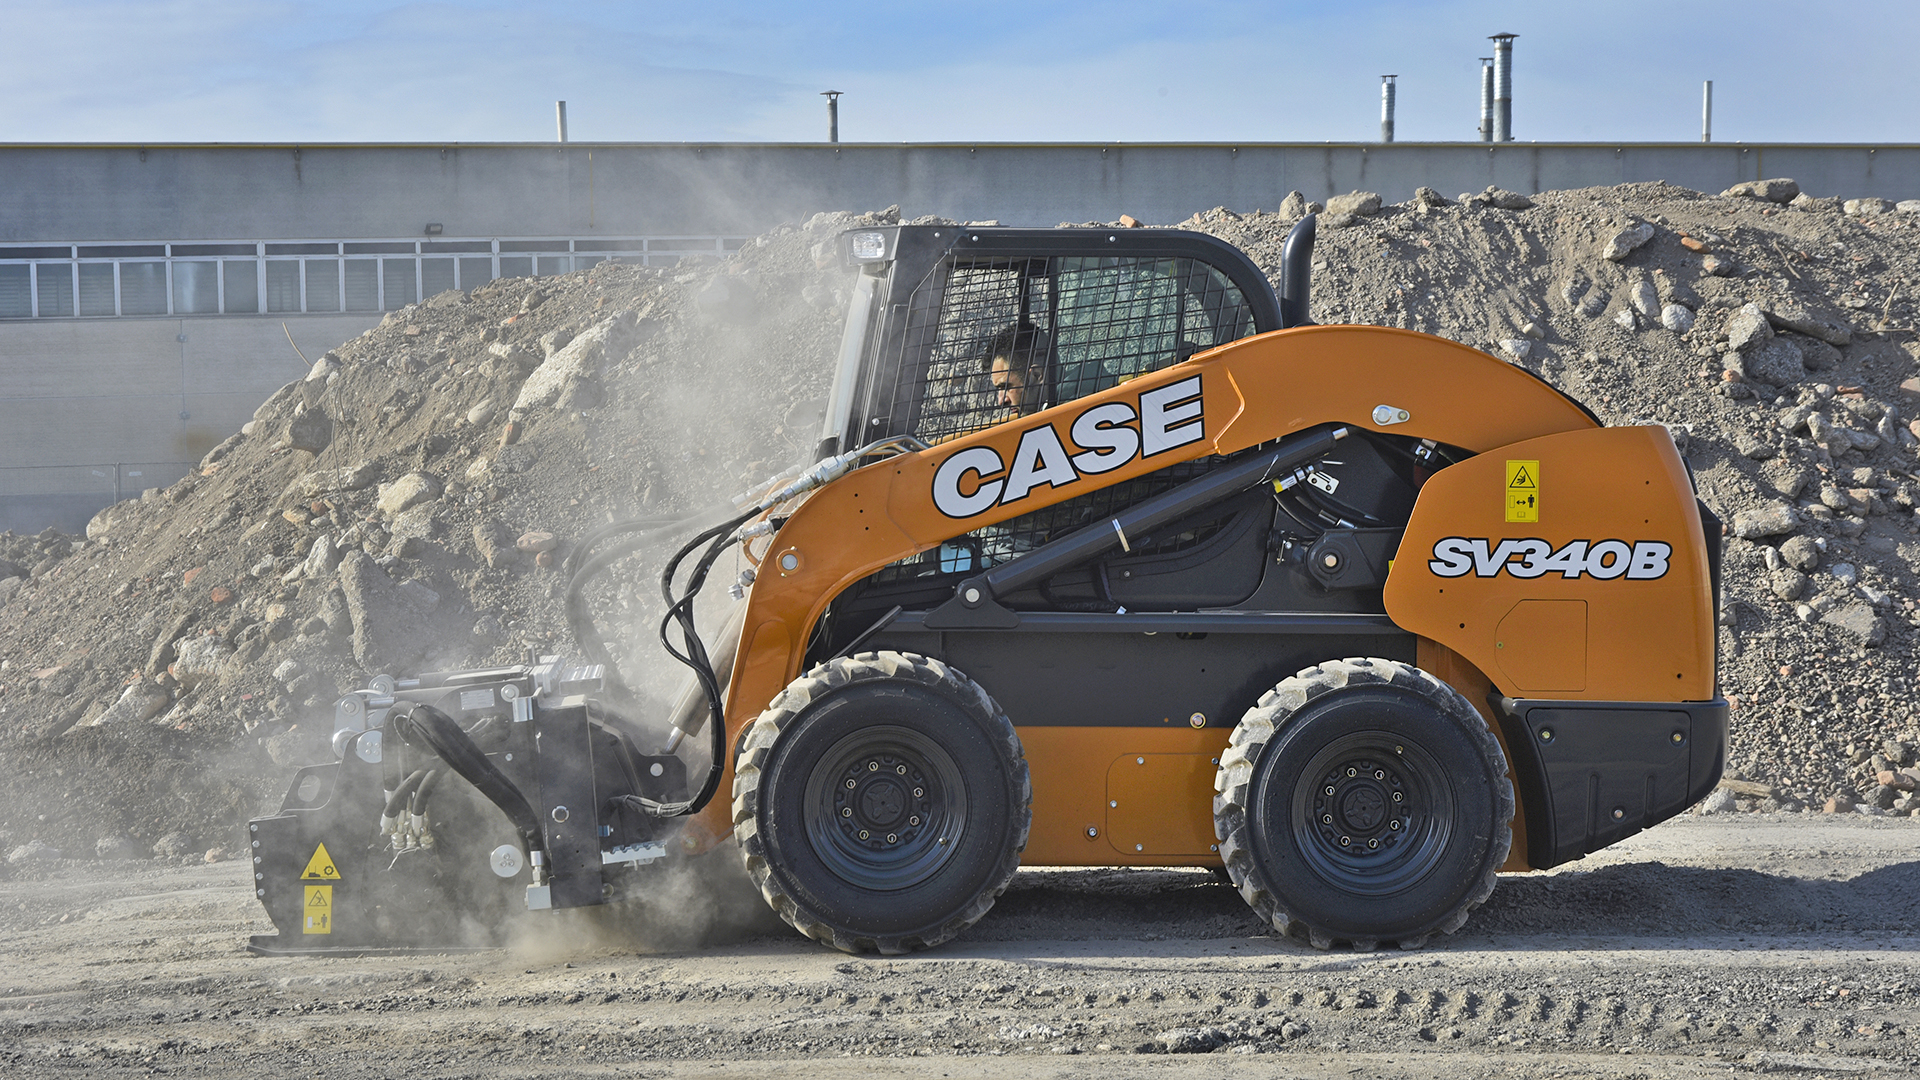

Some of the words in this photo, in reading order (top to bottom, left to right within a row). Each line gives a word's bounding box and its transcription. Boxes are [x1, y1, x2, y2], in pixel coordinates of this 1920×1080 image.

[932, 374, 1205, 519] CASE
[1428, 536, 1673, 580] SV340B
[1082, 602, 1097, 610] PSI
